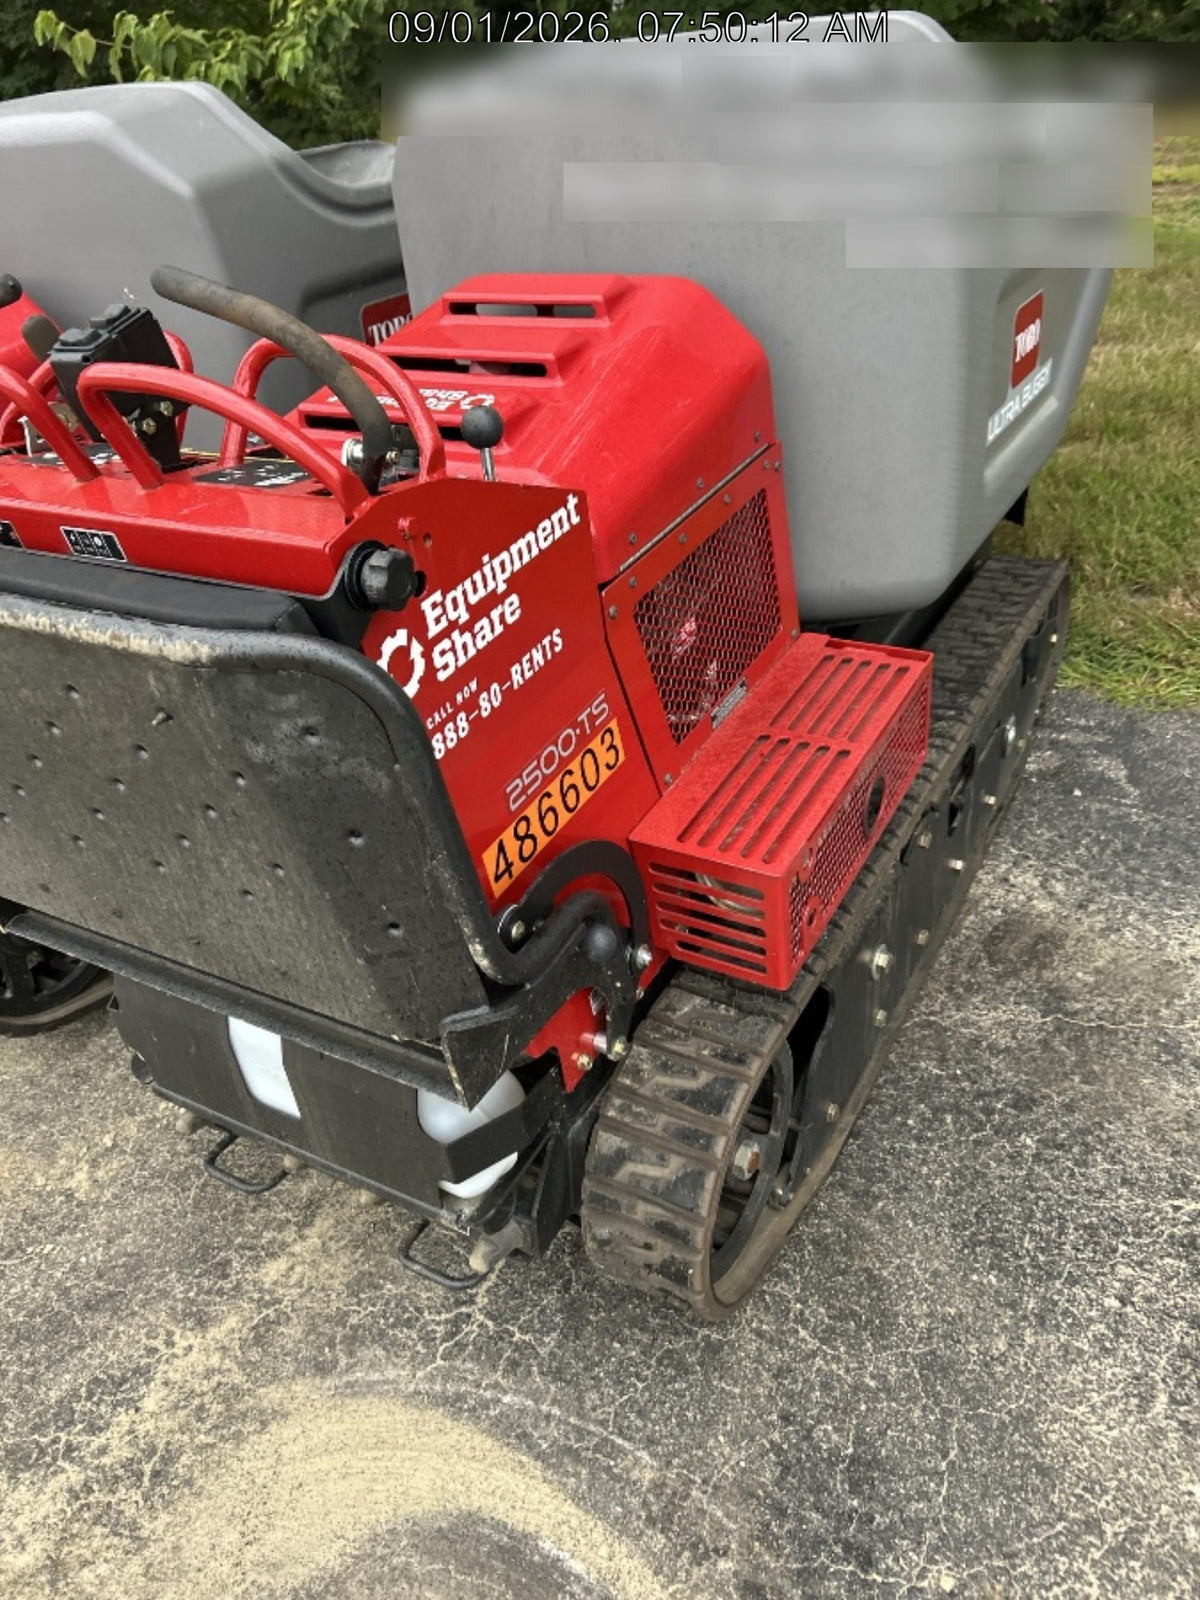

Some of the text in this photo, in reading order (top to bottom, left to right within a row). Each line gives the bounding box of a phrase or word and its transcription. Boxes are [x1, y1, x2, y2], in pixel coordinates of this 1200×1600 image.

[420, 492, 581, 640] Equipment
[426, 677, 478, 730] CALL NOW
[431, 627, 563, 760] 888-80-RENTS
[432, 593, 521, 682] Share
[493, 726, 620, 884] 486603
